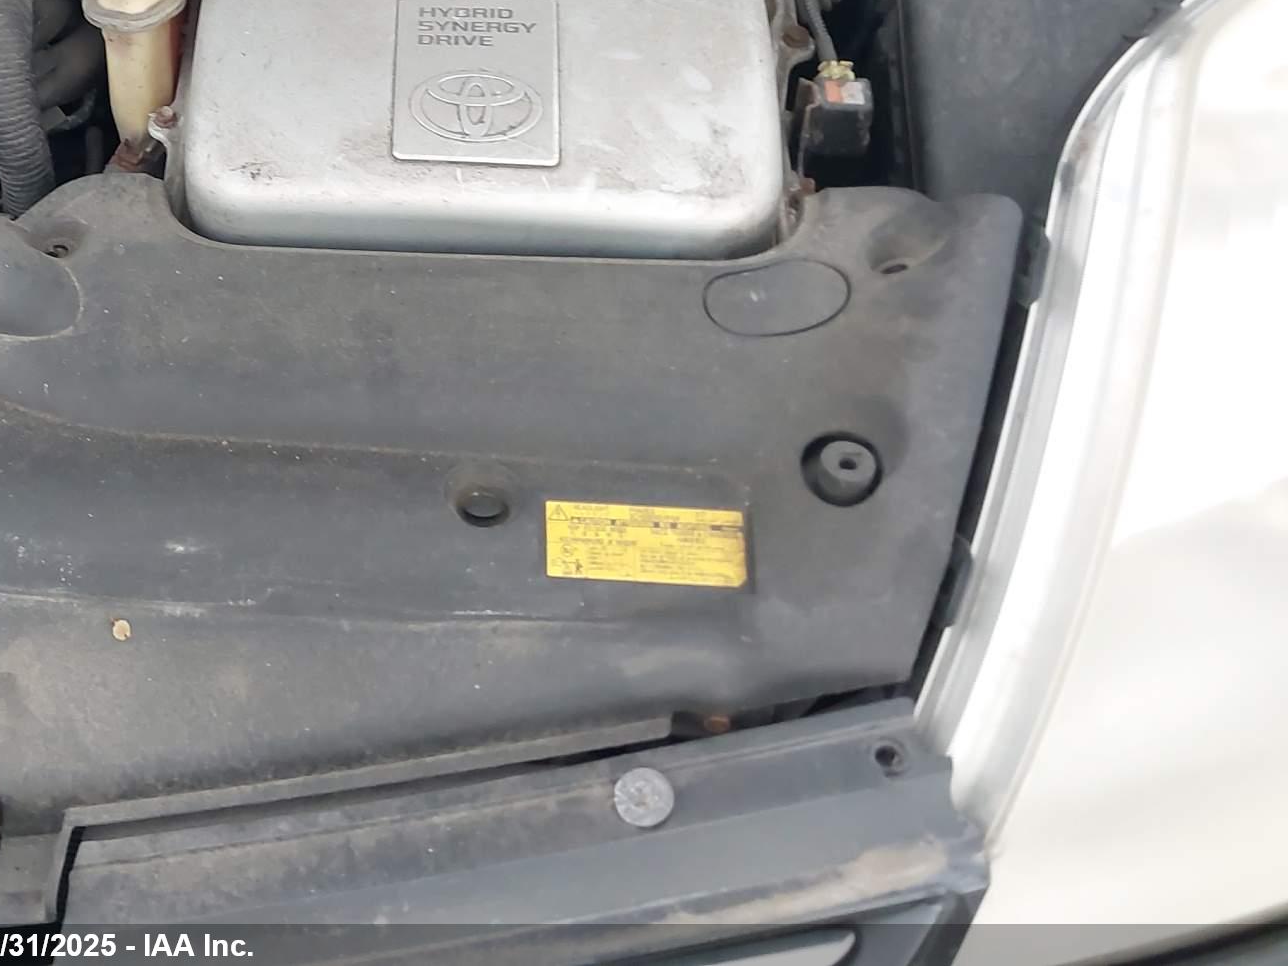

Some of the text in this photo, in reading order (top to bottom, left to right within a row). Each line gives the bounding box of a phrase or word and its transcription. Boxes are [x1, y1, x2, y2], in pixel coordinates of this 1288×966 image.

[418, 6, 514, 20] HYBRID
[417, 20, 537, 34] SYNERGY
[417, 34, 494, 47] DRIVE
